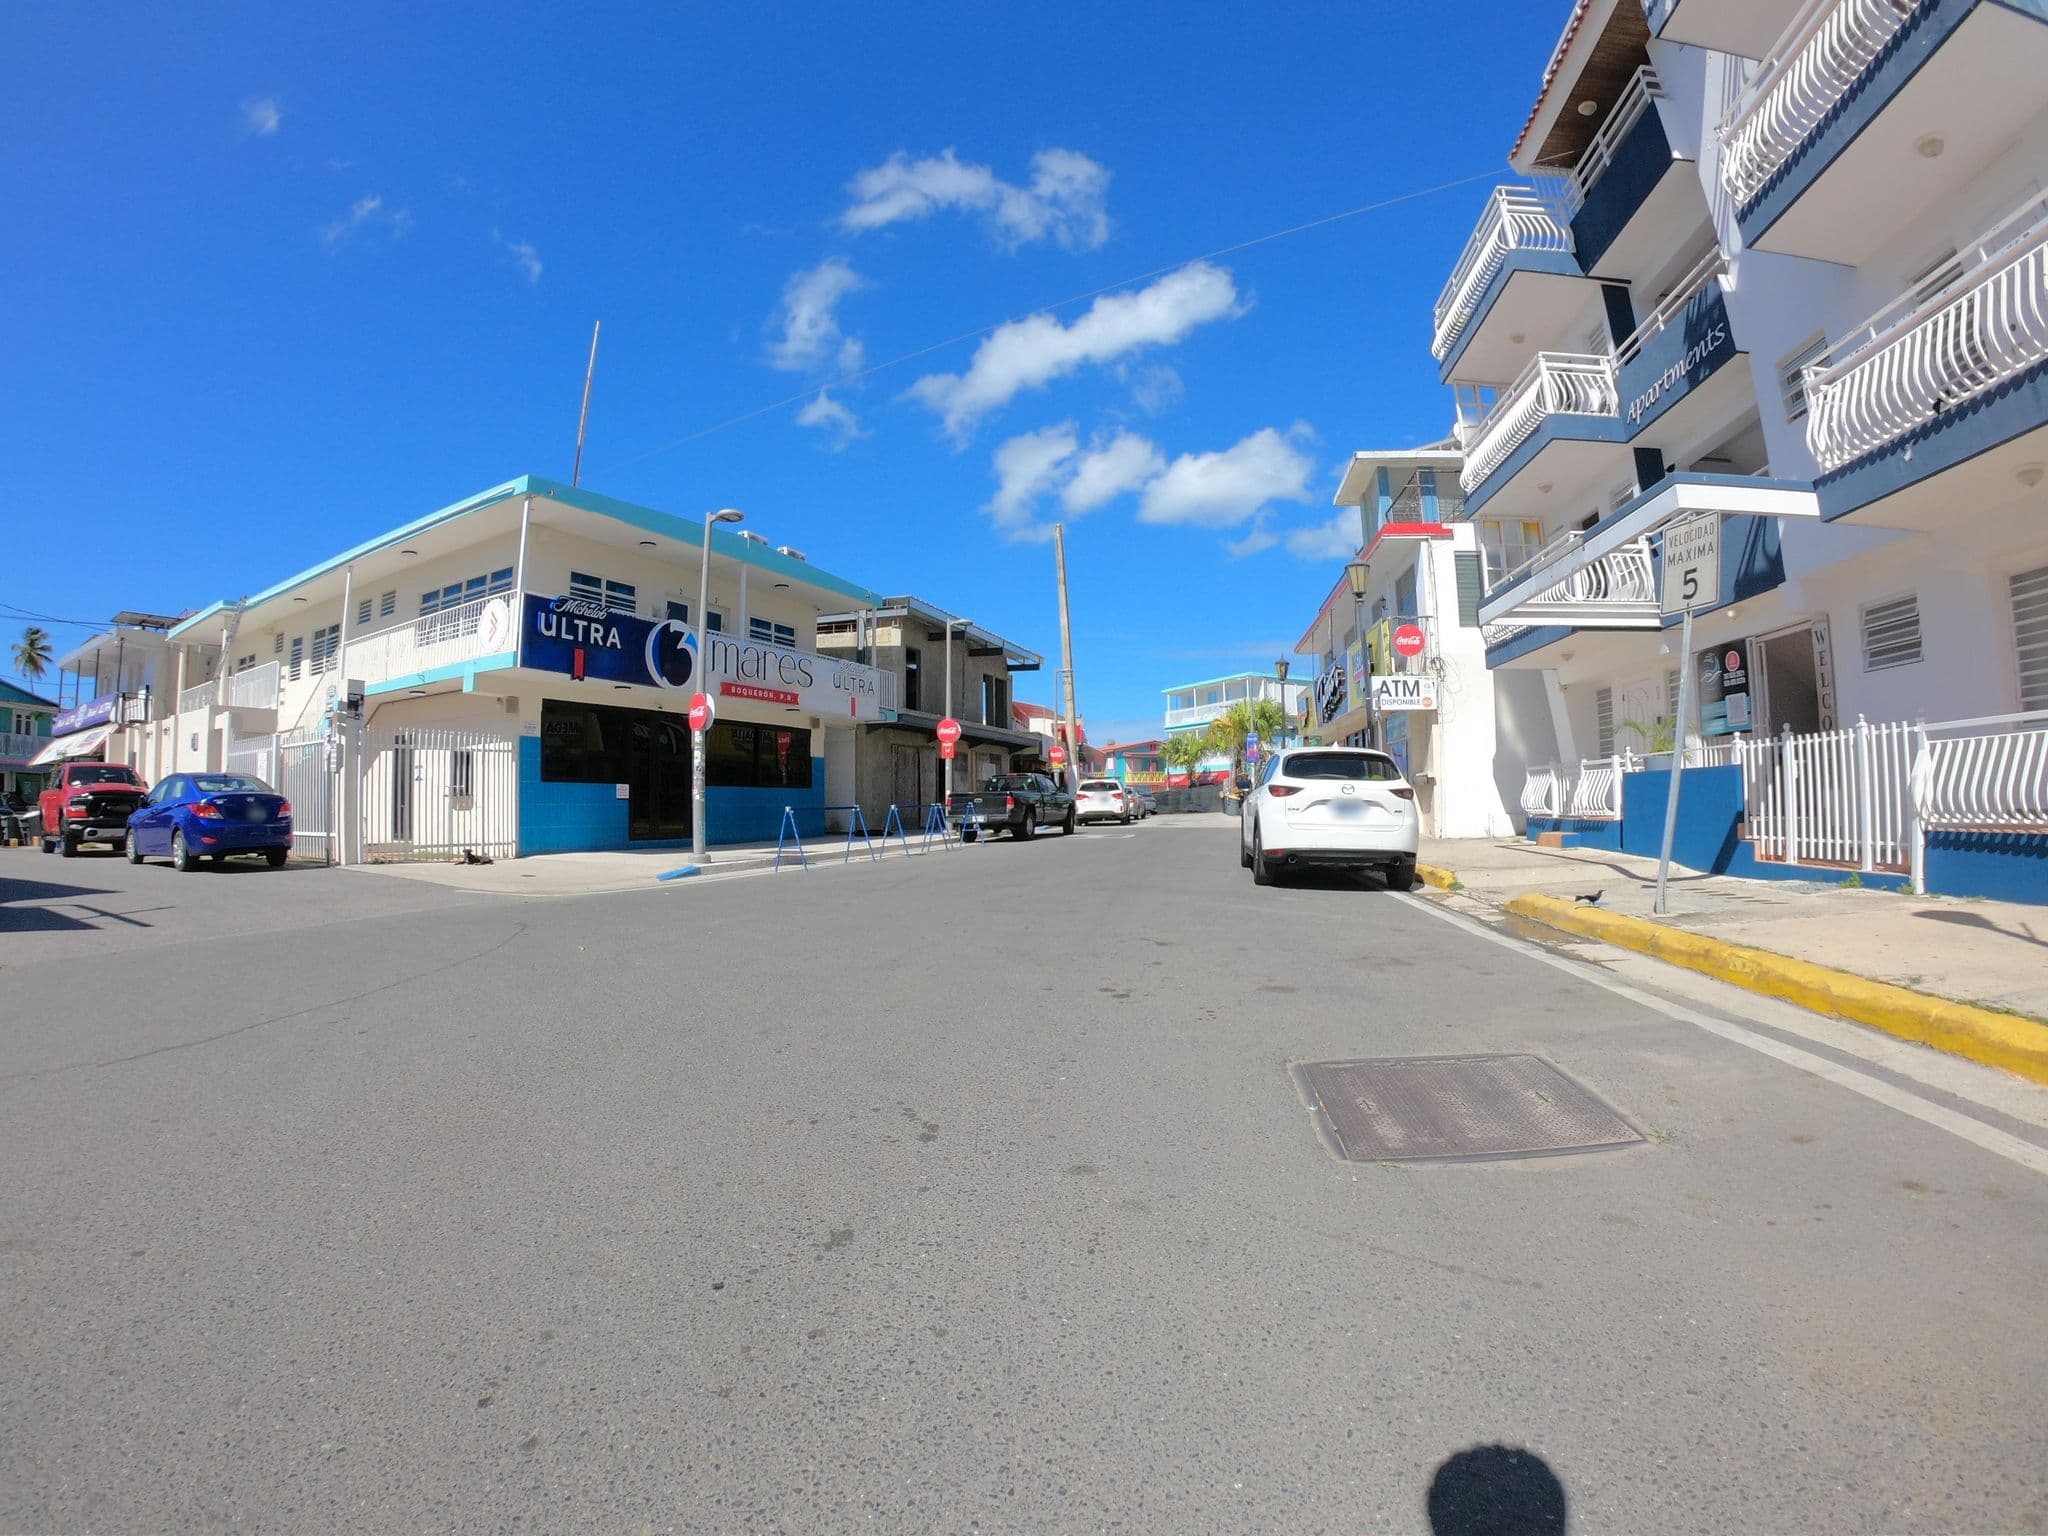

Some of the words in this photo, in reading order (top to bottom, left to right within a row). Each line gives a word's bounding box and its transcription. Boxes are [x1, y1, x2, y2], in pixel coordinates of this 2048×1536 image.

[1627, 322, 1726, 426] Apartments
[1668, 522, 1715, 549] VELOCIDAD
[1667, 541, 1715, 568] MAXIMA
[1682, 567, 1699, 600] 5
[552, 595, 608, 620] Michelob
[540, 612, 621, 649] ULTRA
[711, 640, 814, 688] mares
[832, 672, 875, 696] ULTRA
[1380, 679, 1421, 698] ATM
[1813, 629, 1833, 731] WELCO
[1381, 698, 1421, 706] DISPONIBLE
